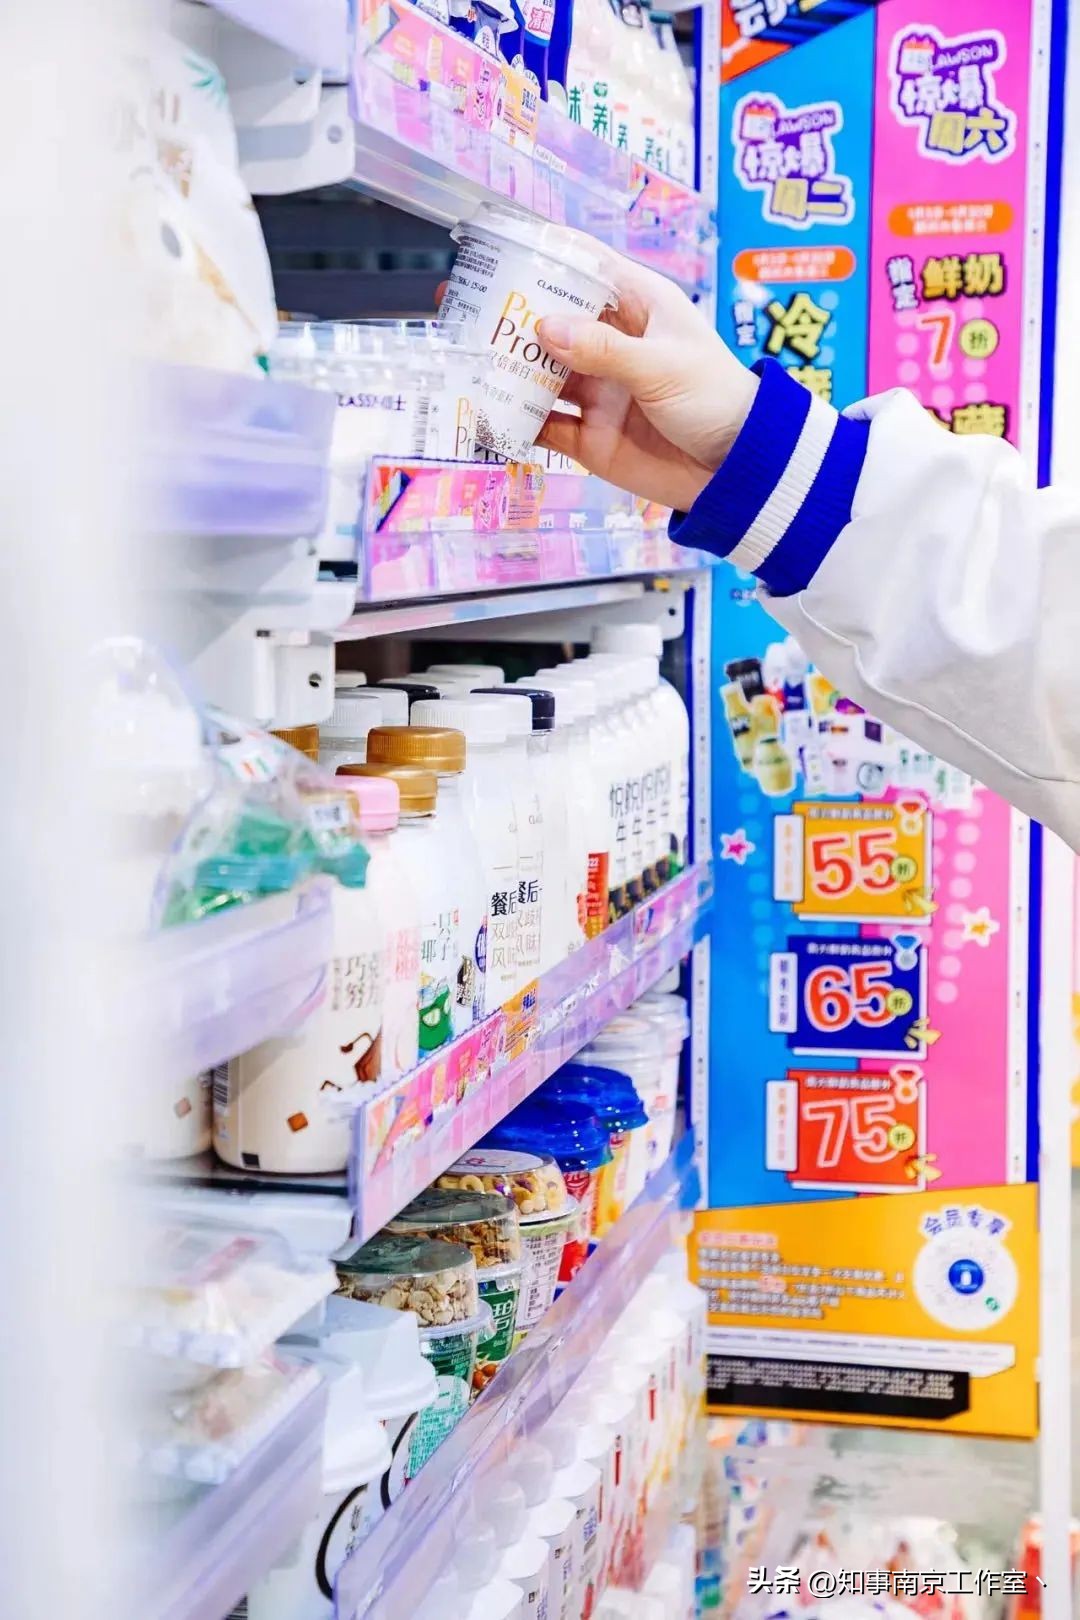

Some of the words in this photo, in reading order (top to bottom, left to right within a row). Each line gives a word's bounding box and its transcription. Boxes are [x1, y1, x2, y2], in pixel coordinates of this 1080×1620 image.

[922, 252, 1004, 300] 鲜奶
[920, 314, 952, 365] 7
[807, 829, 897, 898] 55
[805, 963, 896, 1031] 65
[801, 1095, 899, 1168] 75
